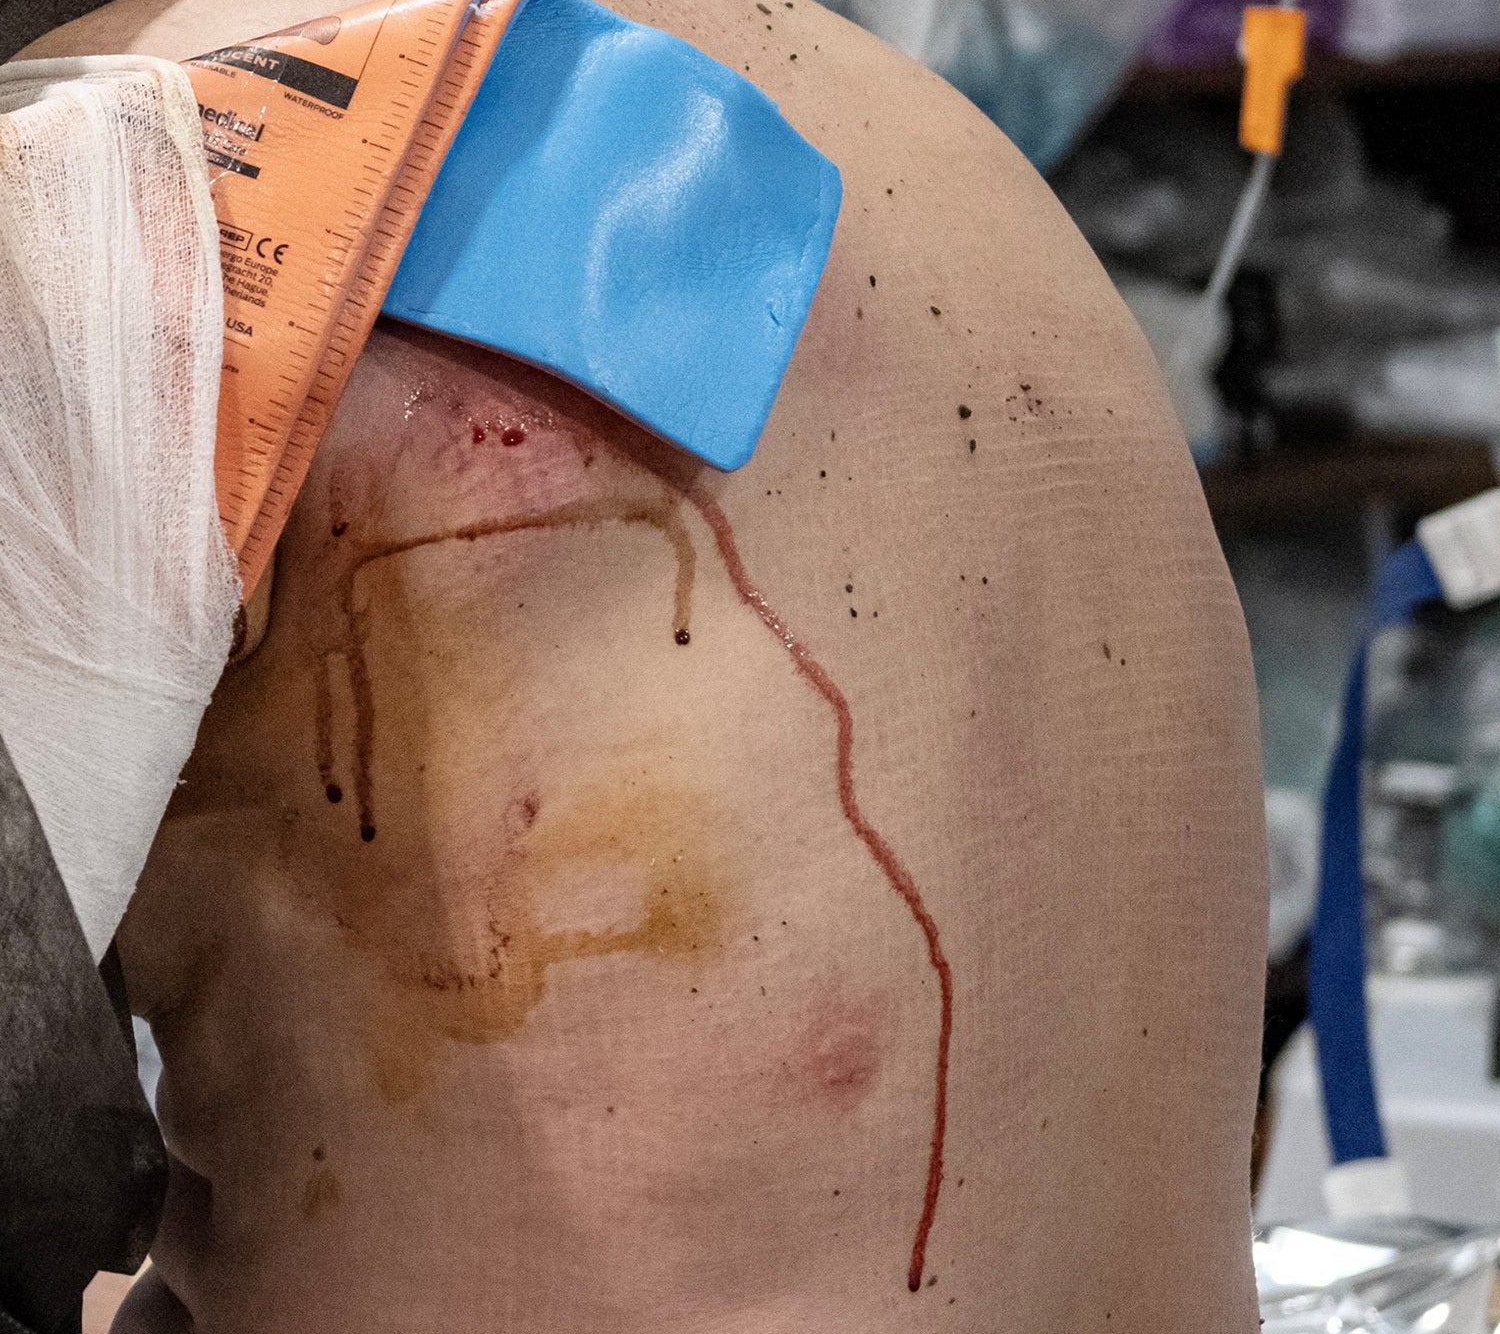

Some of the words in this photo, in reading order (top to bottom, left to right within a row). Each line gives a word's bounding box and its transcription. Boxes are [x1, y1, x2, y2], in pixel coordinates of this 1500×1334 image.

[283, 91, 345, 121] WATERPROOF
[256, 237, 290, 265] CE
[244, 257, 279, 277] Europe
[225, 317, 254, 337] USA
